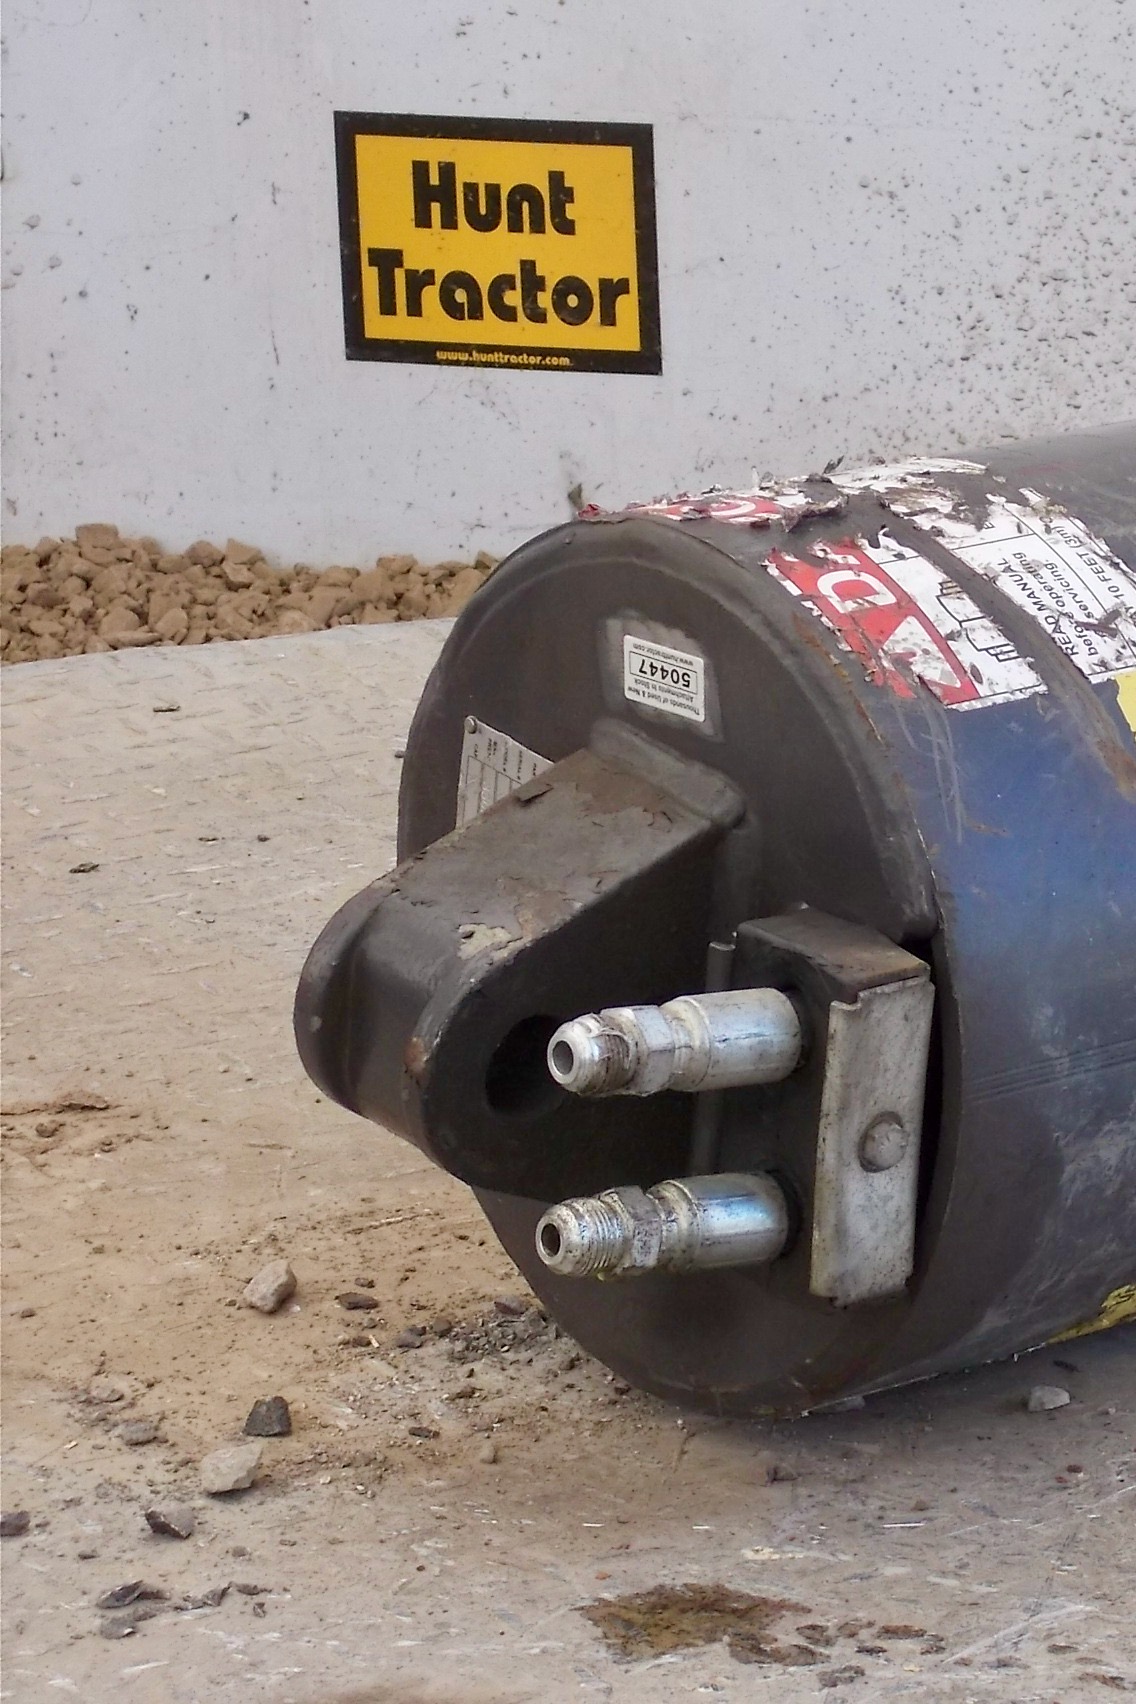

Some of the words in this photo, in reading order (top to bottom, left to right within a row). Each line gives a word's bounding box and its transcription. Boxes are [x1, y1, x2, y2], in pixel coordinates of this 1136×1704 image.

[411, 159, 577, 236] Hunt
[366, 246, 630, 327] Tractor
[435, 349, 572, 367] www.hunttractor.com
[1053, 525, 1083, 550] (3m)
[996, 557, 1047, 612] MANUAL
[1011, 551, 1067, 608] operating
[1076, 551, 1113, 583] FEET
[1106, 585, 1126, 600] 10
[1043, 614, 1080, 657] READ
[639, 659, 690, 687] 50447
